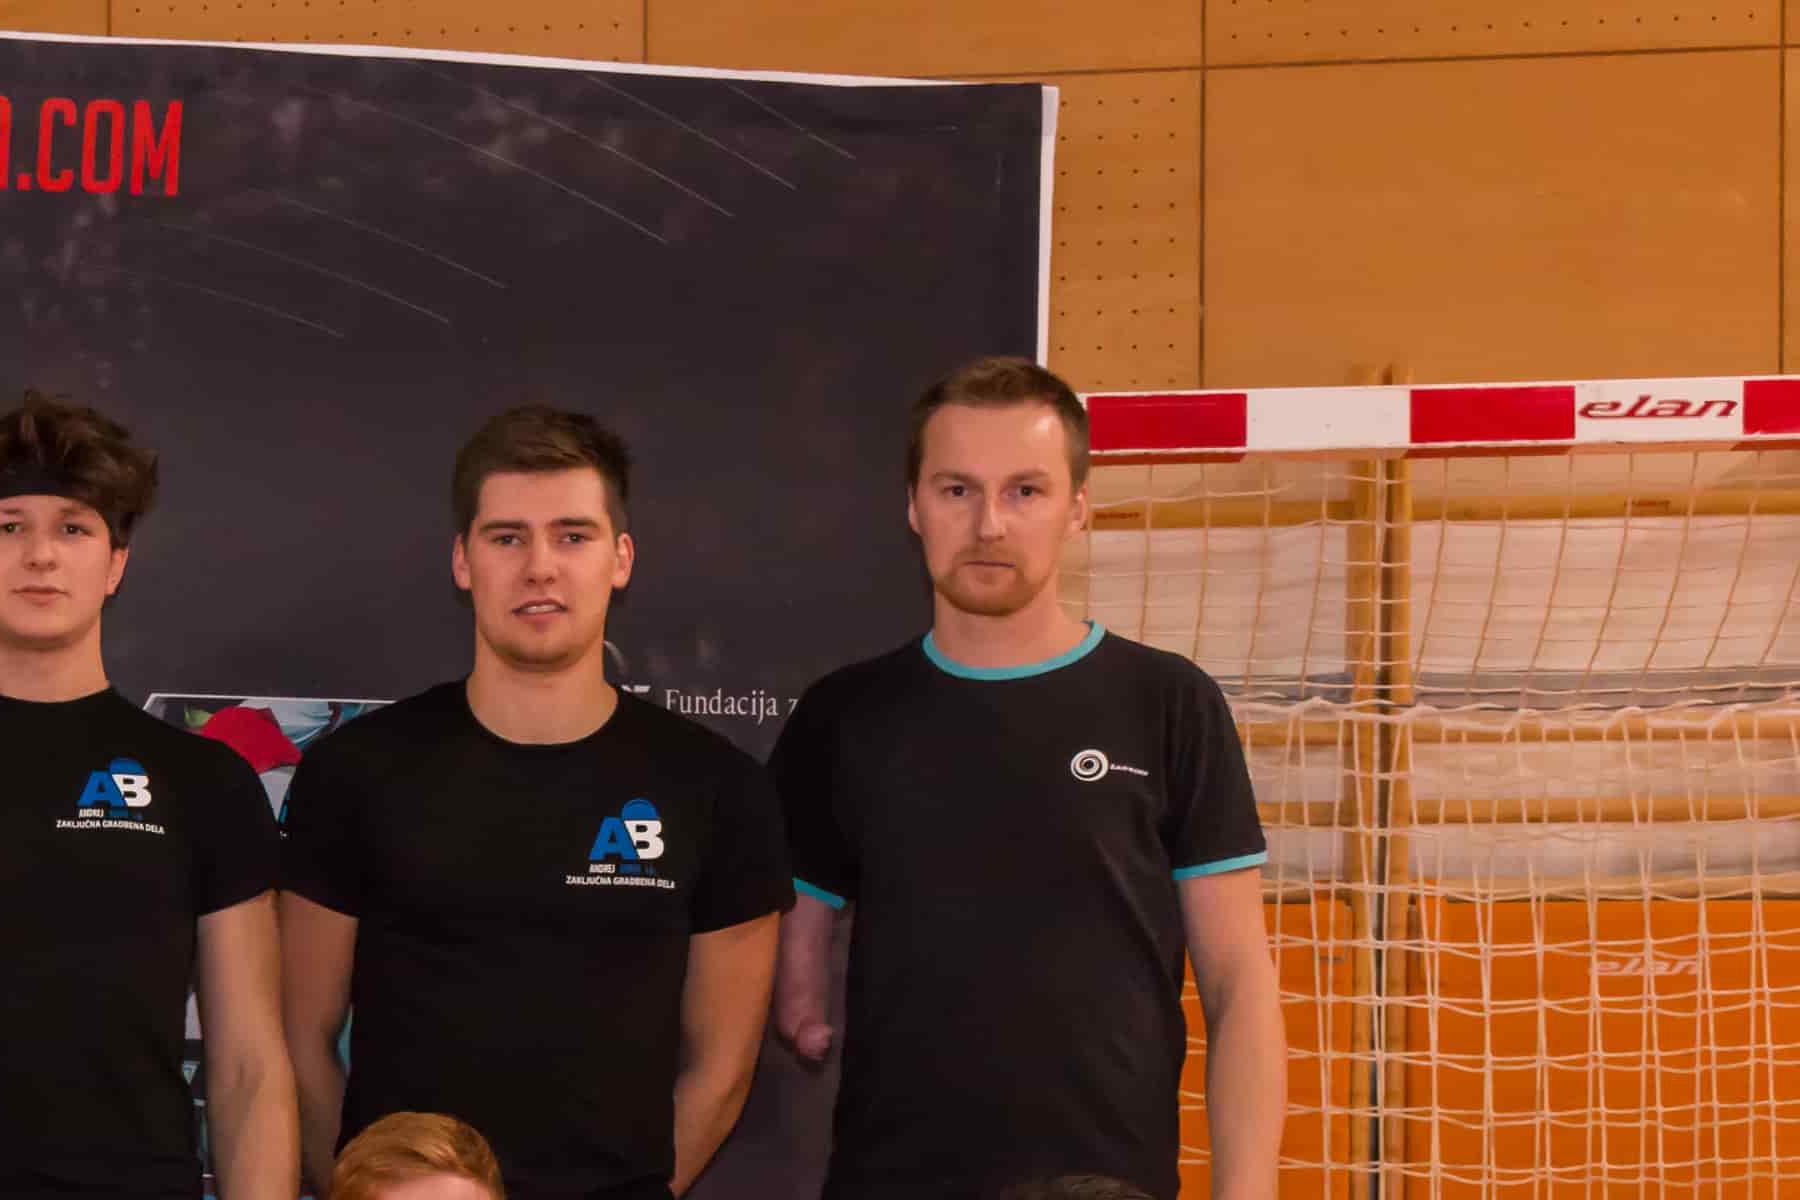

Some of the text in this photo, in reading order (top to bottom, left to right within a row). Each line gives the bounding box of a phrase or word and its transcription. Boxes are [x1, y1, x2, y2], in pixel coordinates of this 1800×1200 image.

[1578, 394, 1739, 419] elan
[664, 687, 779, 725] Fundacija
[77, 769, 152, 808] AB
[588, 816, 665, 861] AB
